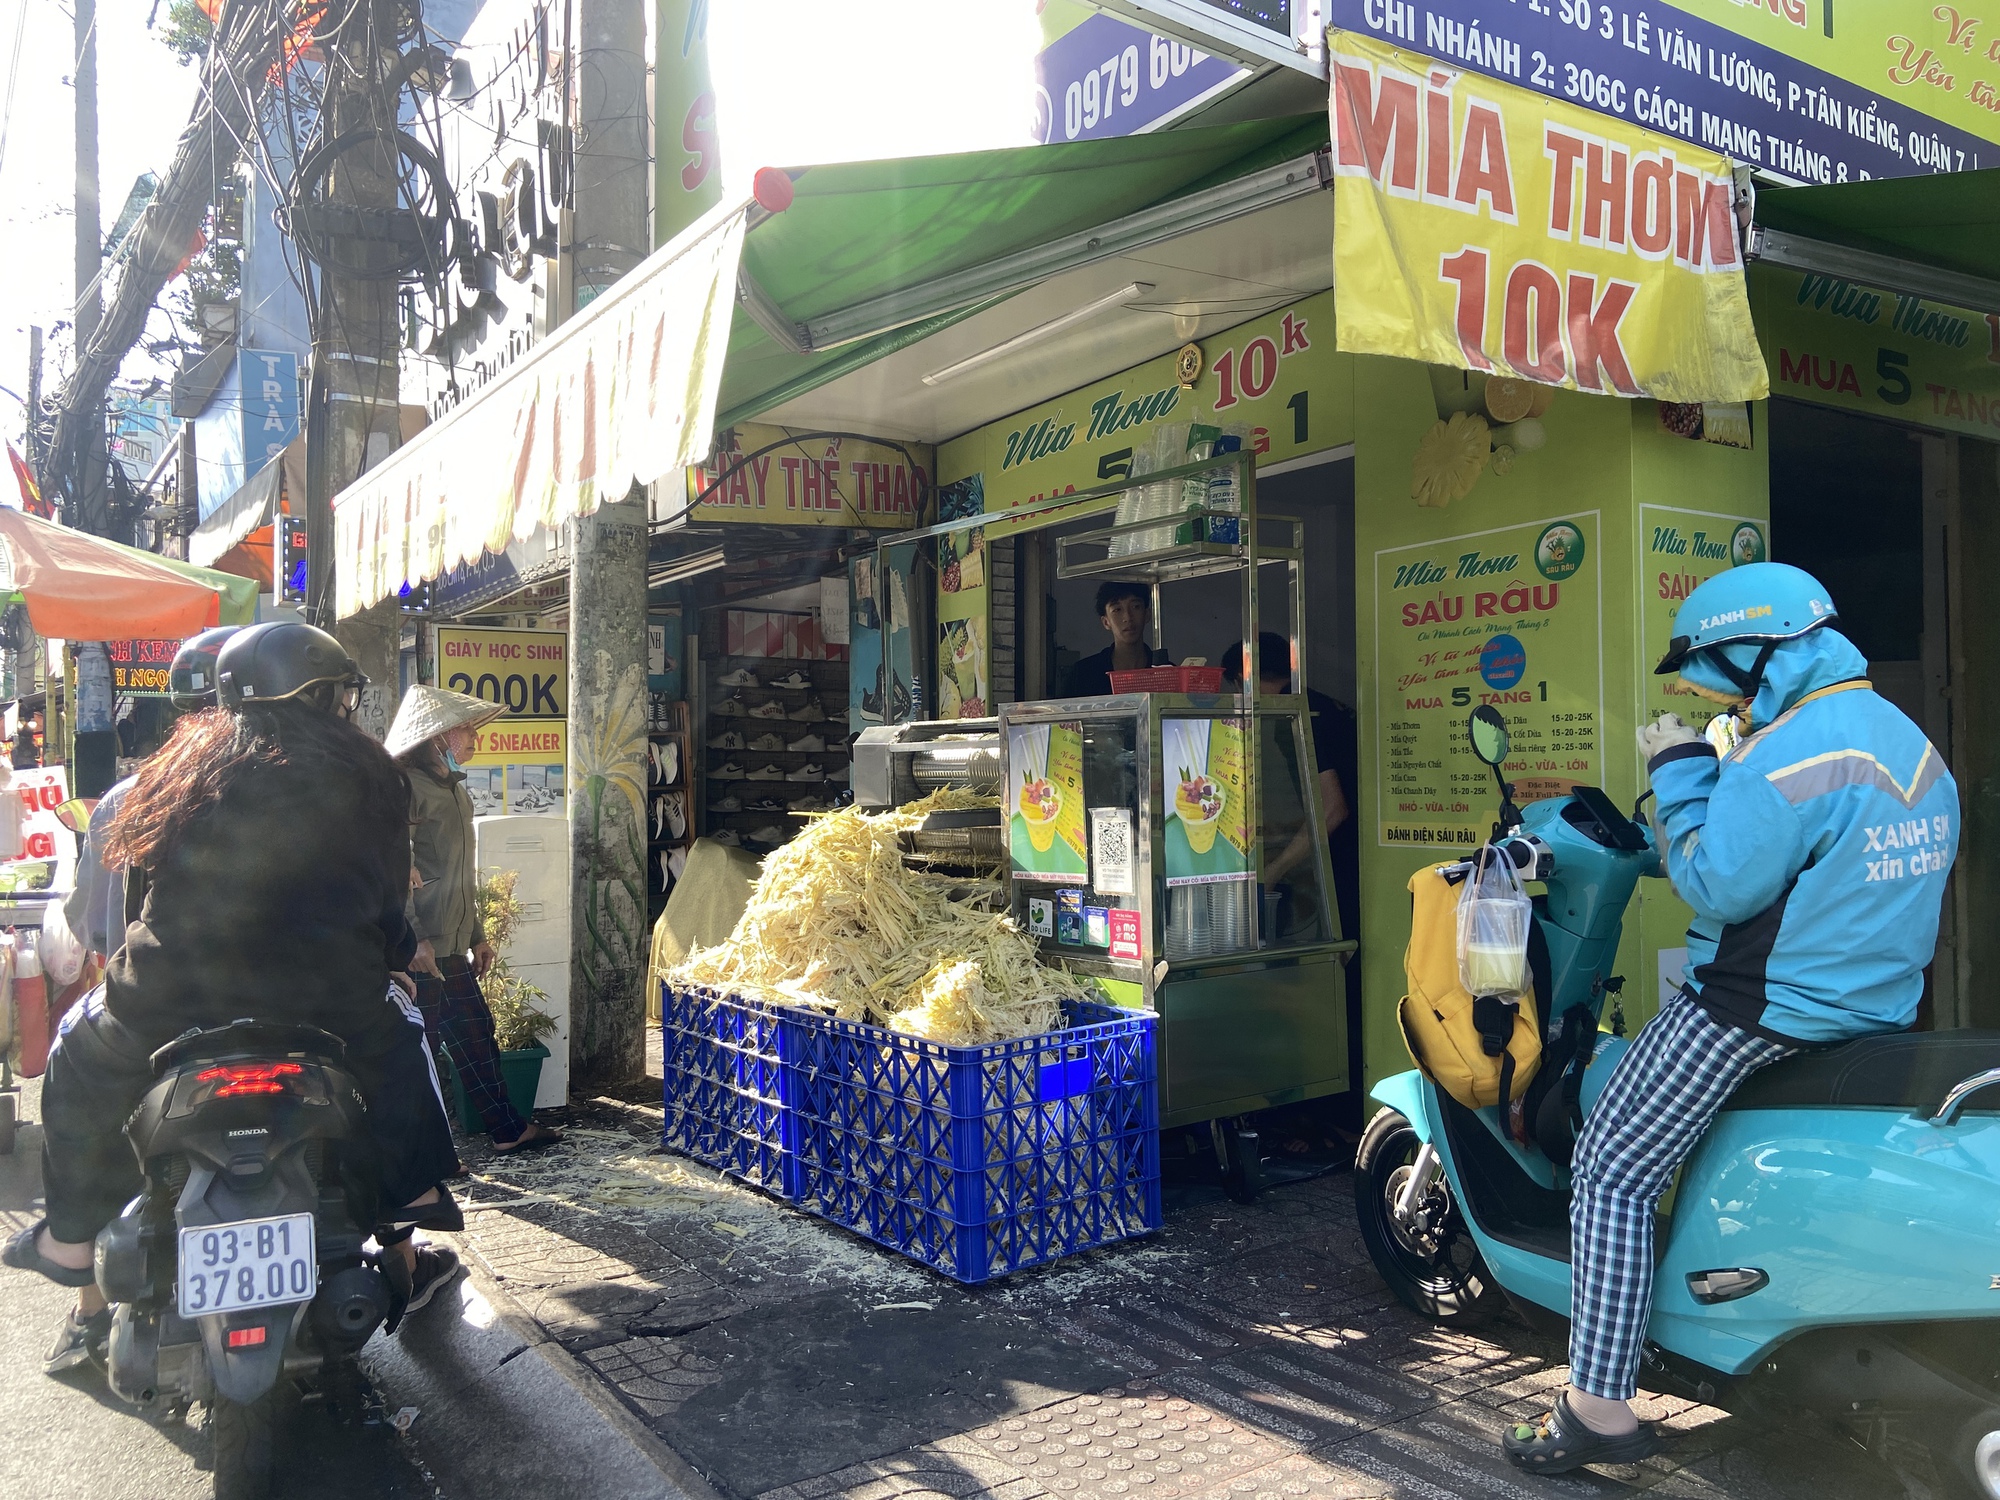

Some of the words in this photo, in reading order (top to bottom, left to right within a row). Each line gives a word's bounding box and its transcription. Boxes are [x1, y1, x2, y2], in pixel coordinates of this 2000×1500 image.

[1932, 4, 1983, 54] Vị
[1886, 35, 1956, 92] Yên
[1065, 44, 1139, 141] 0979
[1149, 33, 1211, 91] 60
[1363, 0, 1415, 41] CHI
[1426, 11, 1521, 78] NHÁNH
[1530, 50, 1556, 90] 2:
[1563, 62, 1627, 114] 306C
[1633, 86, 1694, 138] CÁCH
[1701, 111, 1762, 161] MẠNG
[1766, 138, 1832, 184] THÁNG
[1599, 5, 1614, 40] 3
[1622, 12, 1651, 55] LÊ
[1657, 28, 1701, 75] VĂN
[1708, 48, 1782, 112] LƯƠNG,
[1787, 81, 1842, 130] P.TÂN
[1847, 100, 1904, 160] KIỂNG,
[1908, 130, 1952, 173] QUẬN
[1956, 149, 1966, 173] 7
[1333, 60, 1516, 222] MÍA
[1545, 126, 1738, 268] THƠM
[1440, 246, 1644, 398] 10K
[259, 354, 286, 432] TRÀ
[1779, 347, 1862, 398] MUA
[1876, 346, 1912, 406] 5
[1002, 409, 1077, 472] Mía
[1087, 385, 1182, 444] Thơm
[1286, 390, 1309, 445] 1
[696, 438, 770, 508] GIÀY
[779, 437, 843, 511] THỂ
[852, 461, 928, 515] THAO
[1652, 526, 1688, 556] Mía
[1691, 531, 1728, 560] Thơm
[1392, 556, 1448, 589] Mía
[1455, 551, 1519, 580] Thơm
[1401, 591, 1465, 627] SÁU
[1417, 631, 1430, 641] Chi
[1542, 618, 1550, 628] 8
[445, 637, 483, 658] GIÀY
[489, 643, 521, 662] HỌC
[526, 645, 563, 660] SINH
[1418, 650, 1440, 667] Vị
[130, 668, 170, 692] NGỌ
[1398, 673, 1427, 692] Yên
[1406, 697, 1443, 710] MUA
[1451, 686, 1472, 707] 5
[1537, 681, 1548, 702] 1
[489, 732, 561, 752] SNEAKER
[1067, 776, 1076, 788] 5
[1230, 773, 1239, 786] 5
[1503, 759, 1528, 772] NHỎ
[1536, 758, 1557, 771] VỪA
[1566, 758, 1589, 770] LỚN
[1398, 800, 1418, 812] NHỎ
[1425, 801, 1444, 812] VỪA
[1451, 801, 1469, 812] LỚN
[1387, 826, 1411, 841] ĐÁNH
[1413, 826, 1434, 844] ĐIỆN
[1436, 827, 1454, 843] SÁU
[1457, 827, 1476, 843] RÂU
[1862, 818, 1930, 853] XANH
[1865, 853, 1904, 882] xin
[1040, 926, 1051, 934] LIFE
[228, 1127, 268, 1137] HONDA
[202, 1221, 291, 1267] 93-B1
[189, 1259, 308, 1310] 378.00
